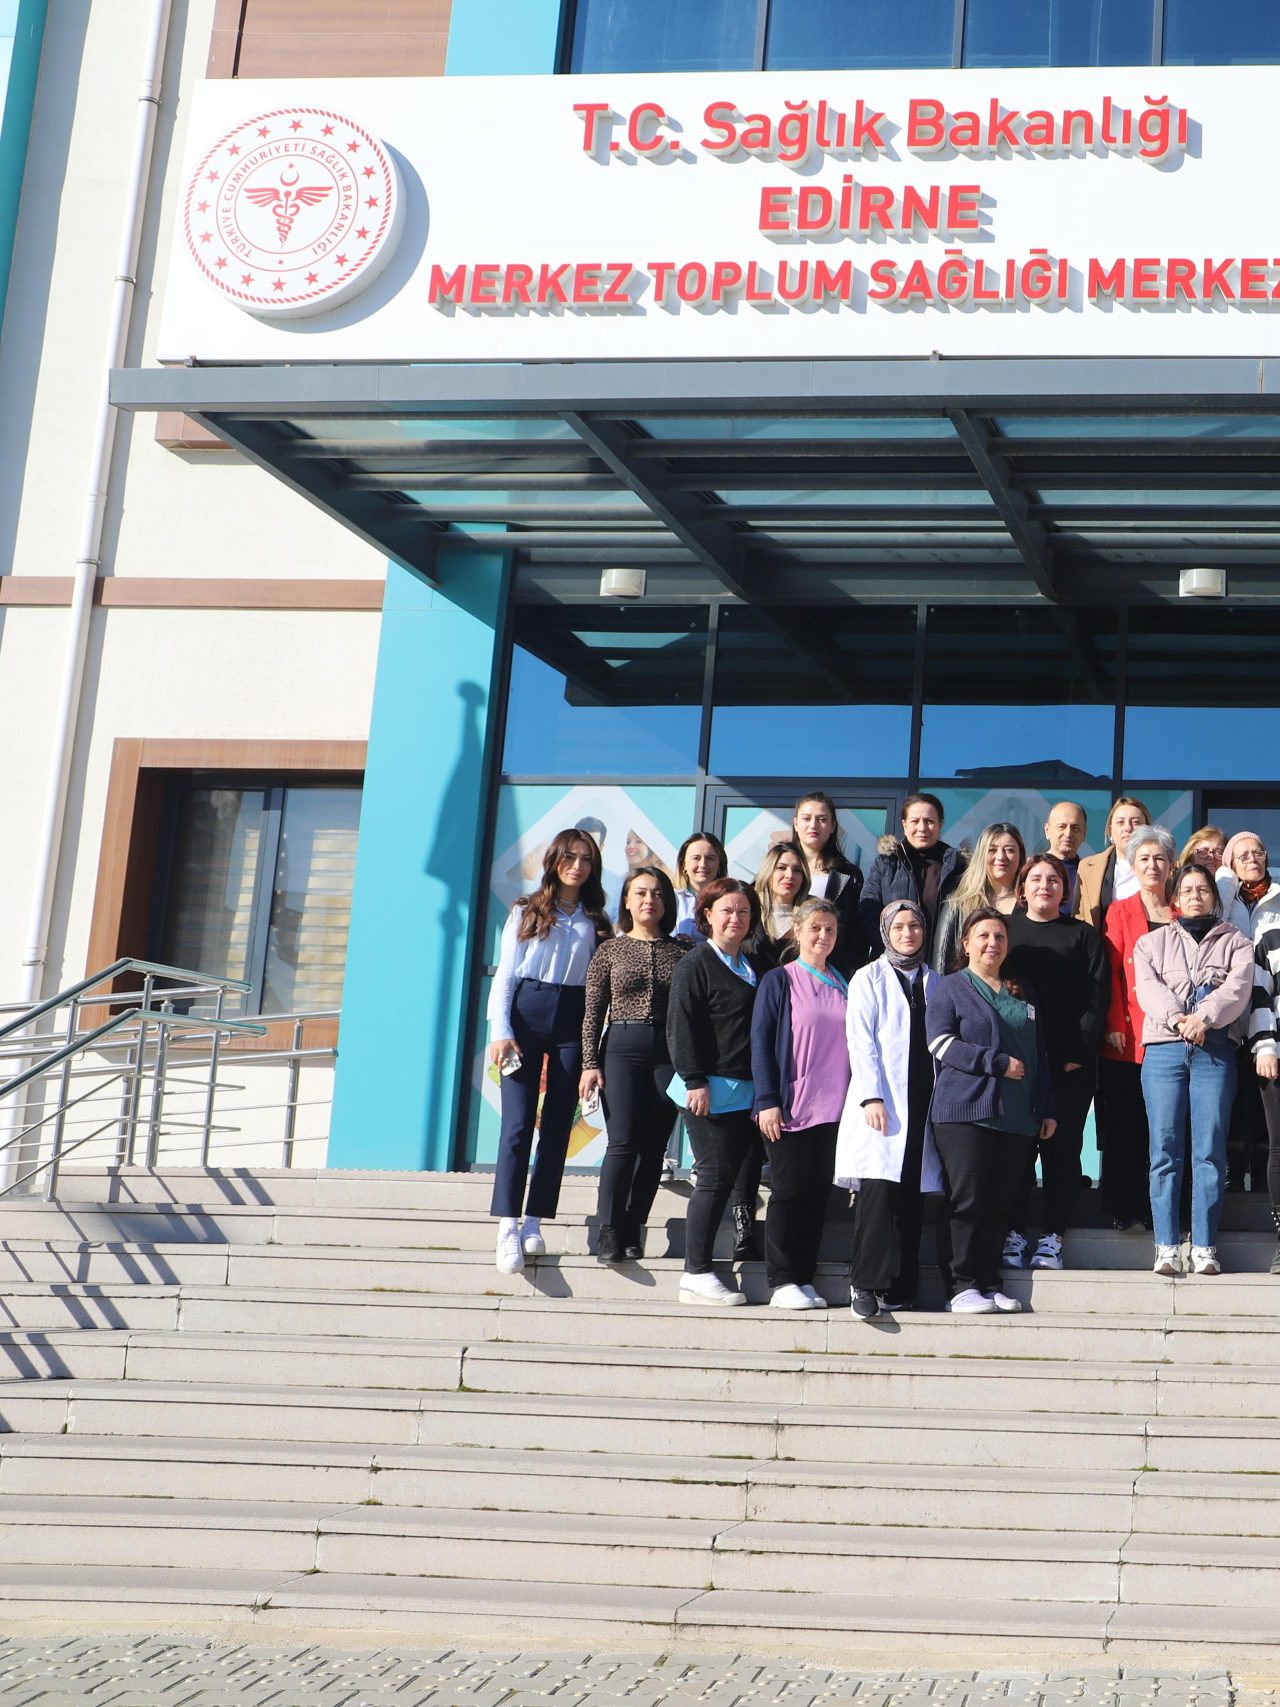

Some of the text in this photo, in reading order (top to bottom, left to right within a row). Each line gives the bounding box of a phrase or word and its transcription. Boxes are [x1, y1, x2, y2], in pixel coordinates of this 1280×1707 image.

[573, 95, 1188, 161] T.C. Sağlık Bakanlığı
[222, 142, 352, 258] TÜRKİYE CUMHURİYETİ SAĞLIK BAKANLIĞI
[759, 174, 981, 231] EDİRNE
[428, 263, 633, 304] MERKEZ
[647, 260, 852, 302] TOPLUM
[868, 248, 1068, 300] SAĞLIĞI
